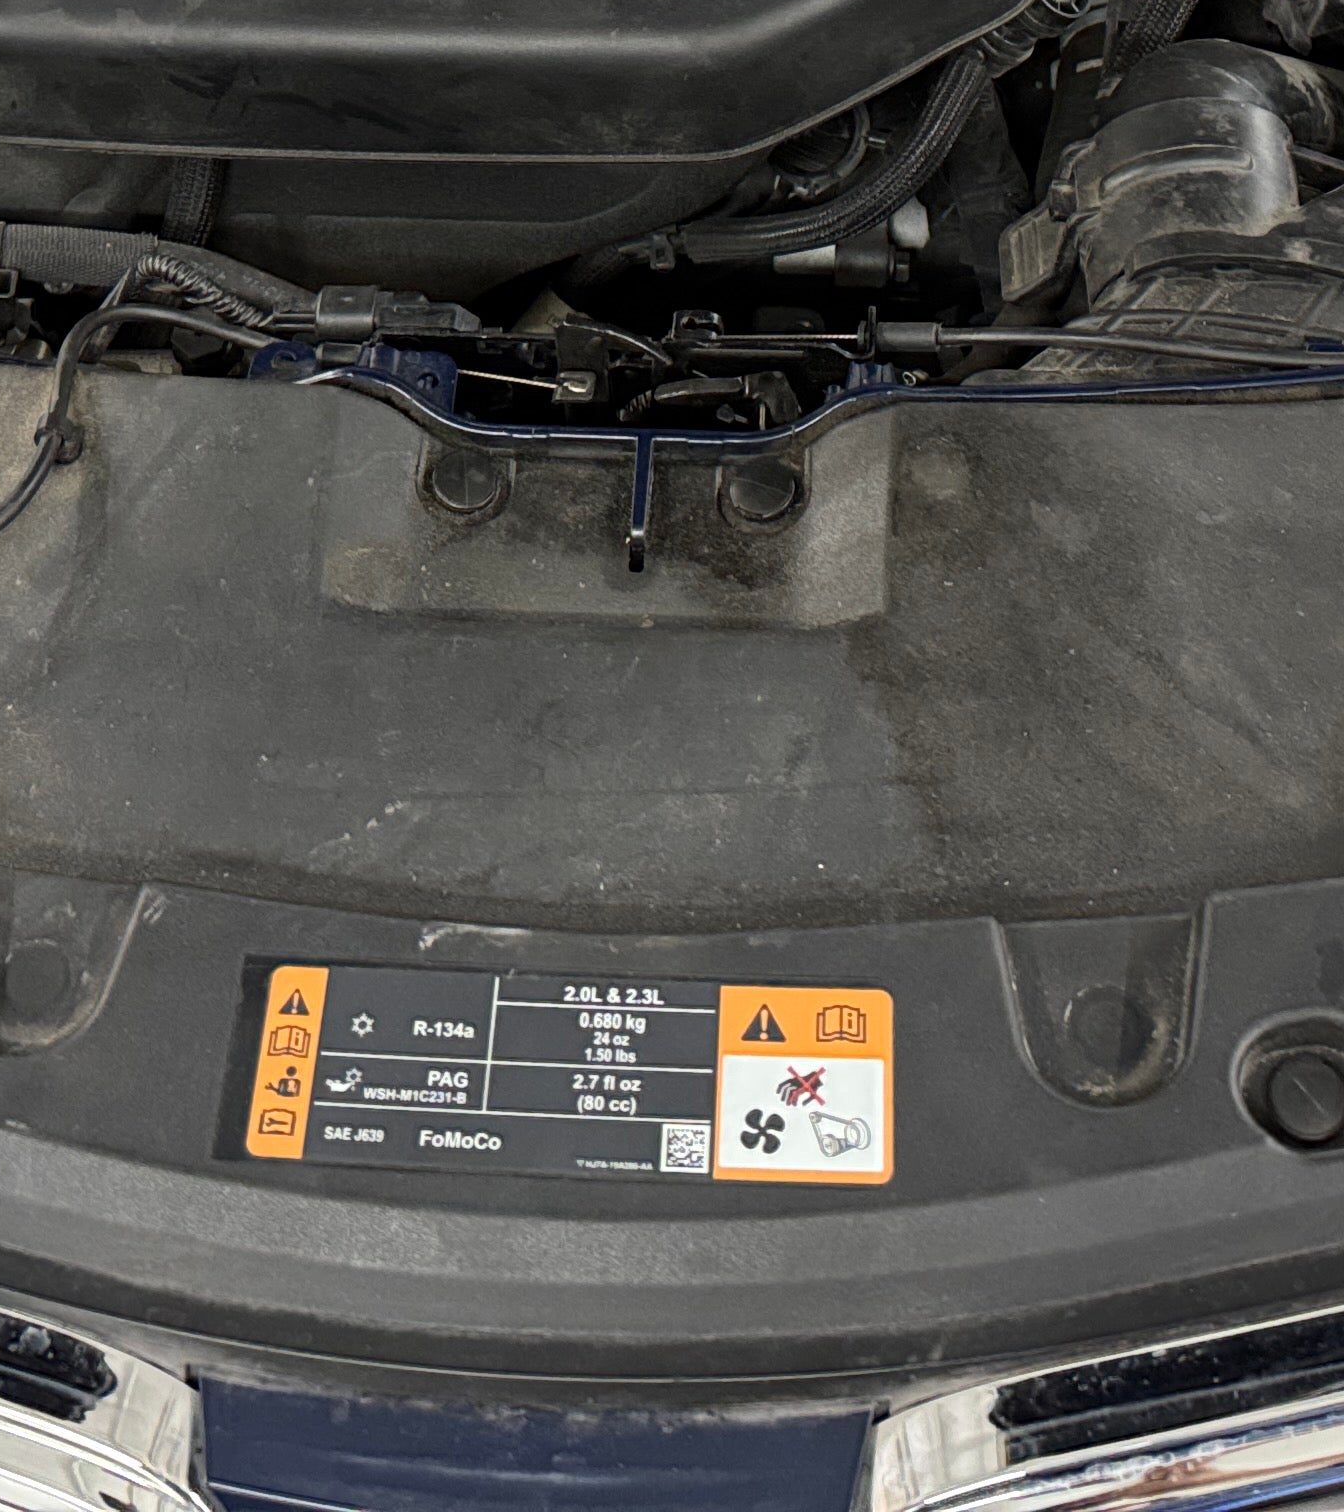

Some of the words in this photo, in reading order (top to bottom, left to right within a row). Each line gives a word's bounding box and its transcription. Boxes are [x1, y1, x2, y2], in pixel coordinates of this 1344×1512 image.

[563, 986, 602, 1003] 2.0L
[606, 987, 621, 1003] &
[625, 988, 665, 1005] 2.3L
[413, 1019, 476, 1039] R-134a
[579, 1012, 622, 1029] 0.680
[626, 1014, 646, 1034] kg
[593, 1032, 610, 1045] 24
[613, 1035, 630, 1046] oz
[585, 1048, 612, 1062] 1.50
[615, 1049, 636, 1063] lbs
[427, 1070, 468, 1089] PAG
[572, 1074, 600, 1090] 2.7
[604, 1075, 615, 1090] fl
[620, 1078, 641, 1091] oz
[362, 1087, 468, 1105] WSH-M1C231-B
[577, 1095, 604, 1115] (80
[608, 1097, 636, 1116] cc)
[323, 1126, 352, 1141] SAE
[353, 1128, 385, 1143] J639
[419, 1129, 502, 1150] FoMoCo
